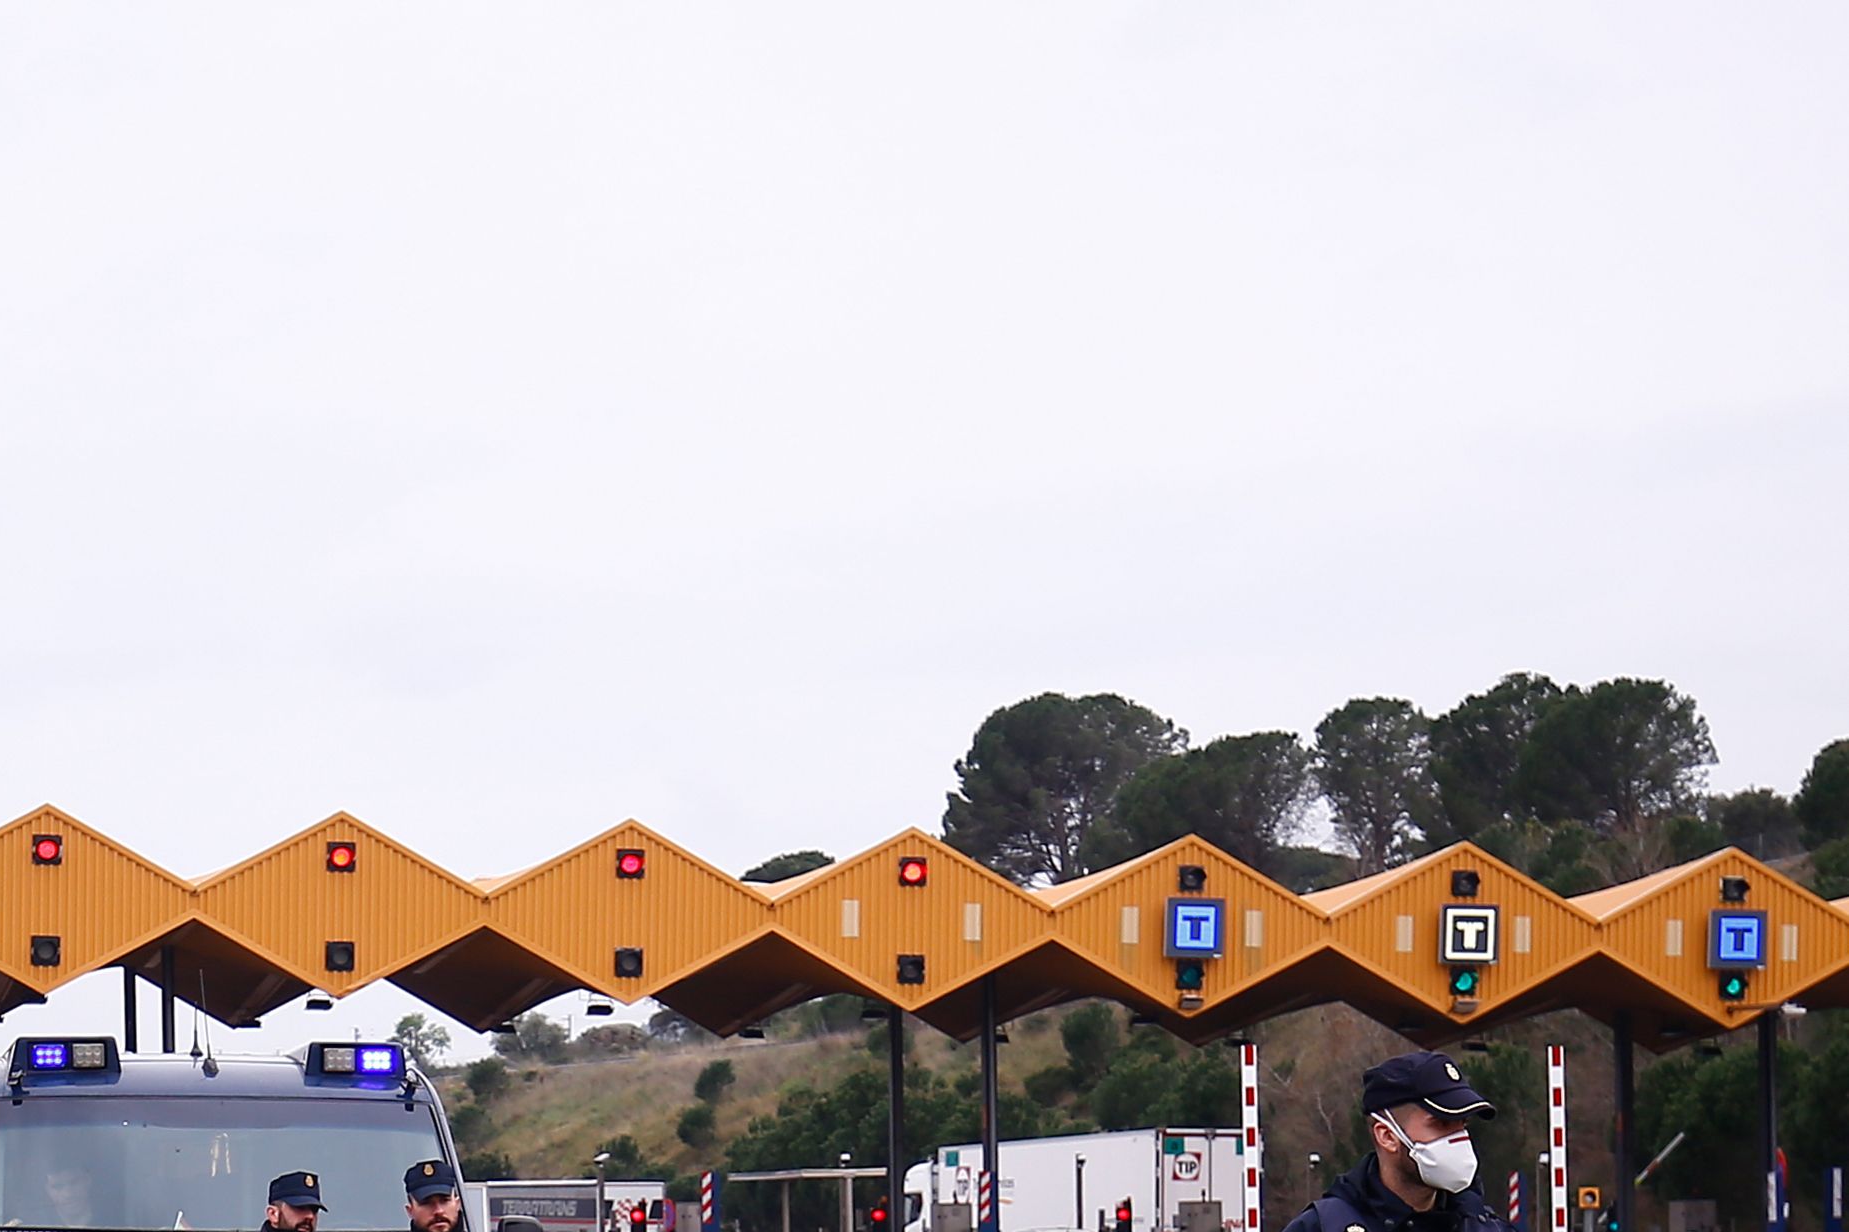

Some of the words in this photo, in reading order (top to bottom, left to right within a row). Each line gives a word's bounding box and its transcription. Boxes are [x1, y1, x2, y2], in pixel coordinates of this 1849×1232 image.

[1182, 914, 1209, 940] T
[1456, 921, 1485, 949] T
[1726, 927, 1753, 951] T
[1178, 1161, 1198, 1174] TIP
